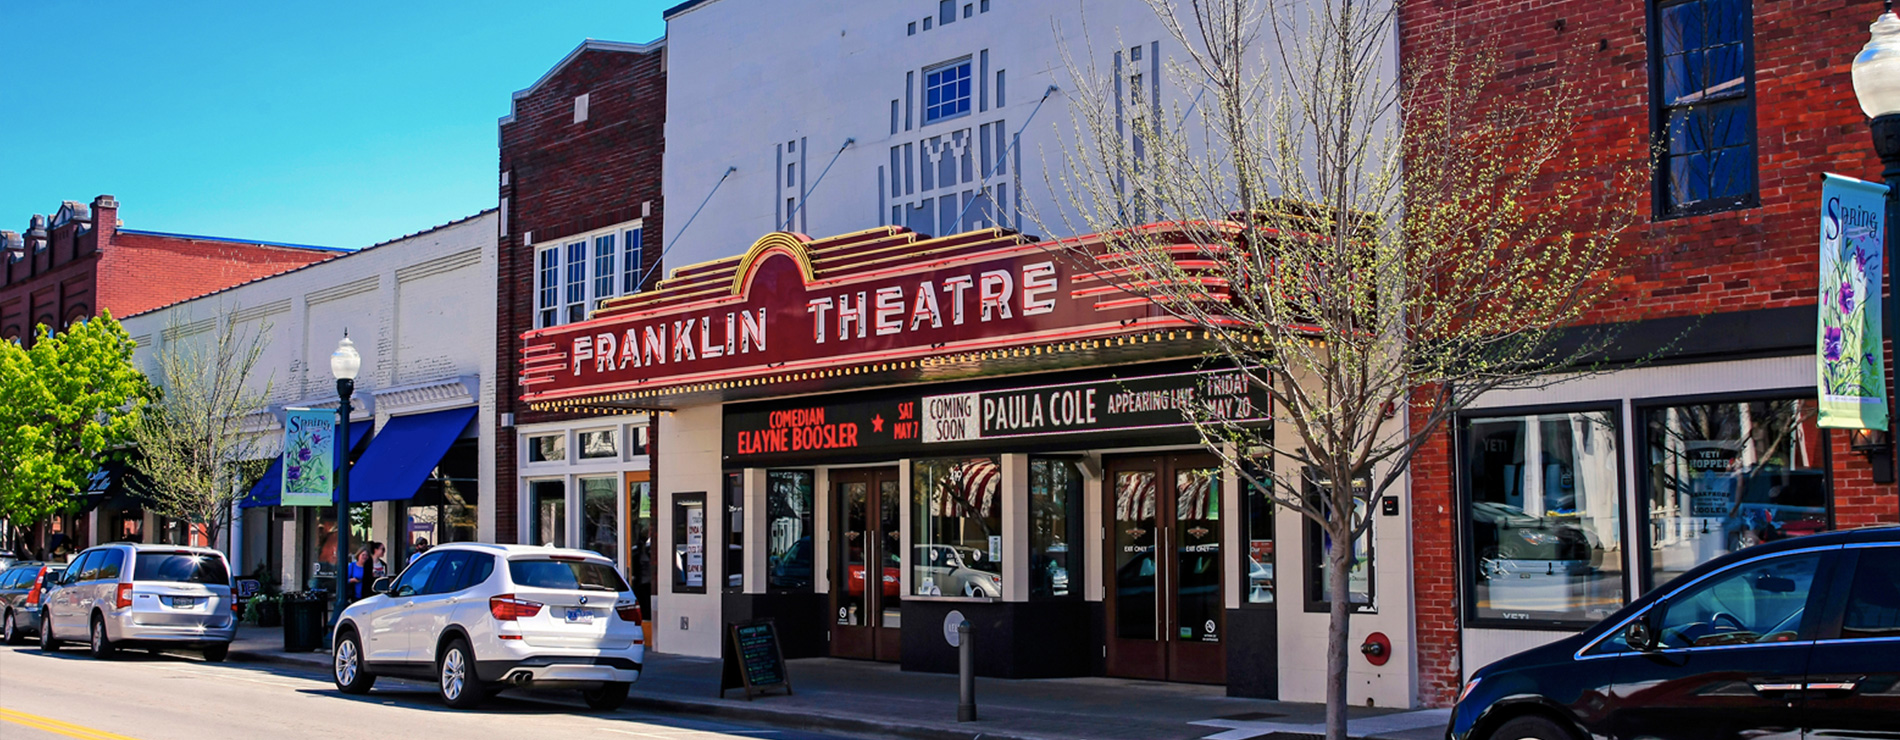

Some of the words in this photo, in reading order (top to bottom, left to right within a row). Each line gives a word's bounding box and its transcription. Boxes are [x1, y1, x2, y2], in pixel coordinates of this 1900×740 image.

[572, 307, 767, 376] FRANKLIN
[807, 260, 1059, 344] THEATRE
[1207, 373, 1250, 396] FRIDAY
[898, 401, 914, 420] SAT
[930, 396, 972, 420] COMING
[983, 393, 1045, 431] PAULA
[1050, 388, 1097, 426] COLE
[1107, 389, 1169, 414] APPEARING
[1170, 387, 1195, 410] LIVE
[1207, 398, 1233, 419] MAY
[1234, 396, 1252, 418] 20
[769, 407, 825, 429] COMEDIAN
[936, 418, 966, 440] SOON
[738, 427, 789, 454] ELAYNE
[792, 422, 858, 451] BOOSLER
[894, 422, 912, 440] MAY
[912, 421, 919, 438] 7
[1482, 438, 1507, 452] YETI
[1699, 450, 1720, 459] YETI
[1689, 459, 1731, 468] HOPPER
